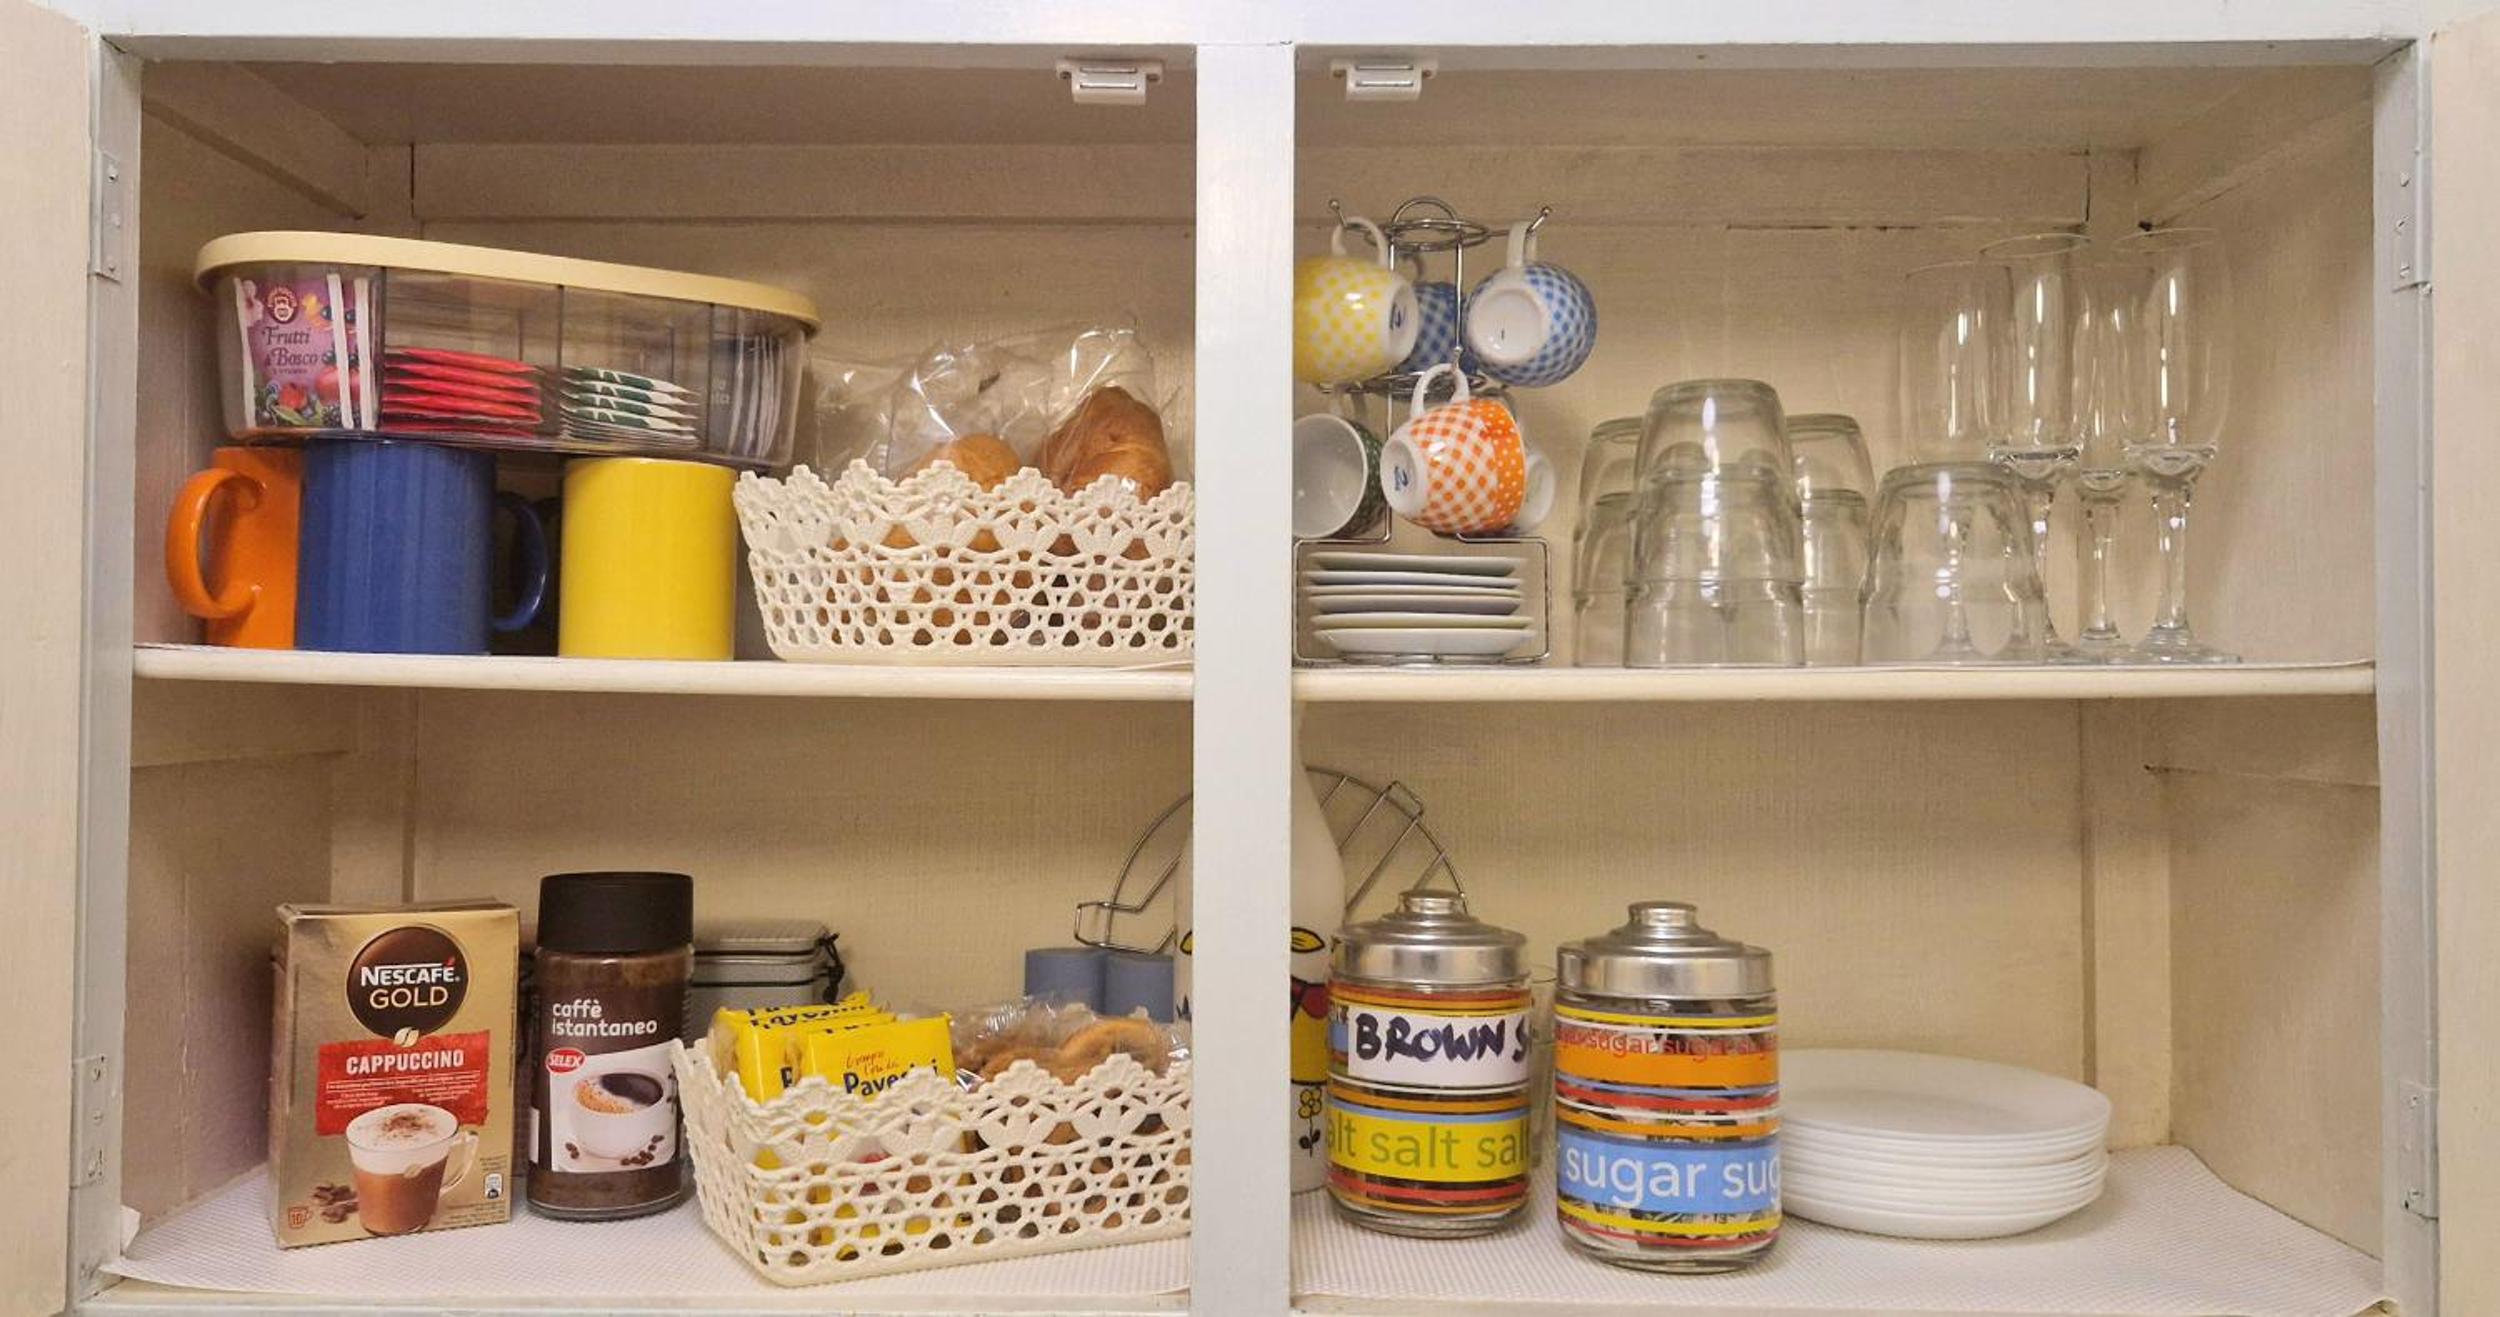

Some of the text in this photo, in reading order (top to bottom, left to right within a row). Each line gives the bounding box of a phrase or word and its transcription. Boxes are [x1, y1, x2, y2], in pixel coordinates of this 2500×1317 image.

[262, 325, 311, 345] Frutti
[272, 346, 319, 367] Bosco
[369, 986, 448, 1009] GOLD
[552, 999, 602, 1018] caffè
[552, 1018, 657, 1037] istantaneo
[1356, 1012, 1506, 1063] BROWN
[346, 1049, 464, 1075] CAPPUCCINO
[548, 1053, 583, 1068] SELEX
[1370, 1125, 1460, 1170] salt
[1565, 1146, 1707, 1208] sugar
